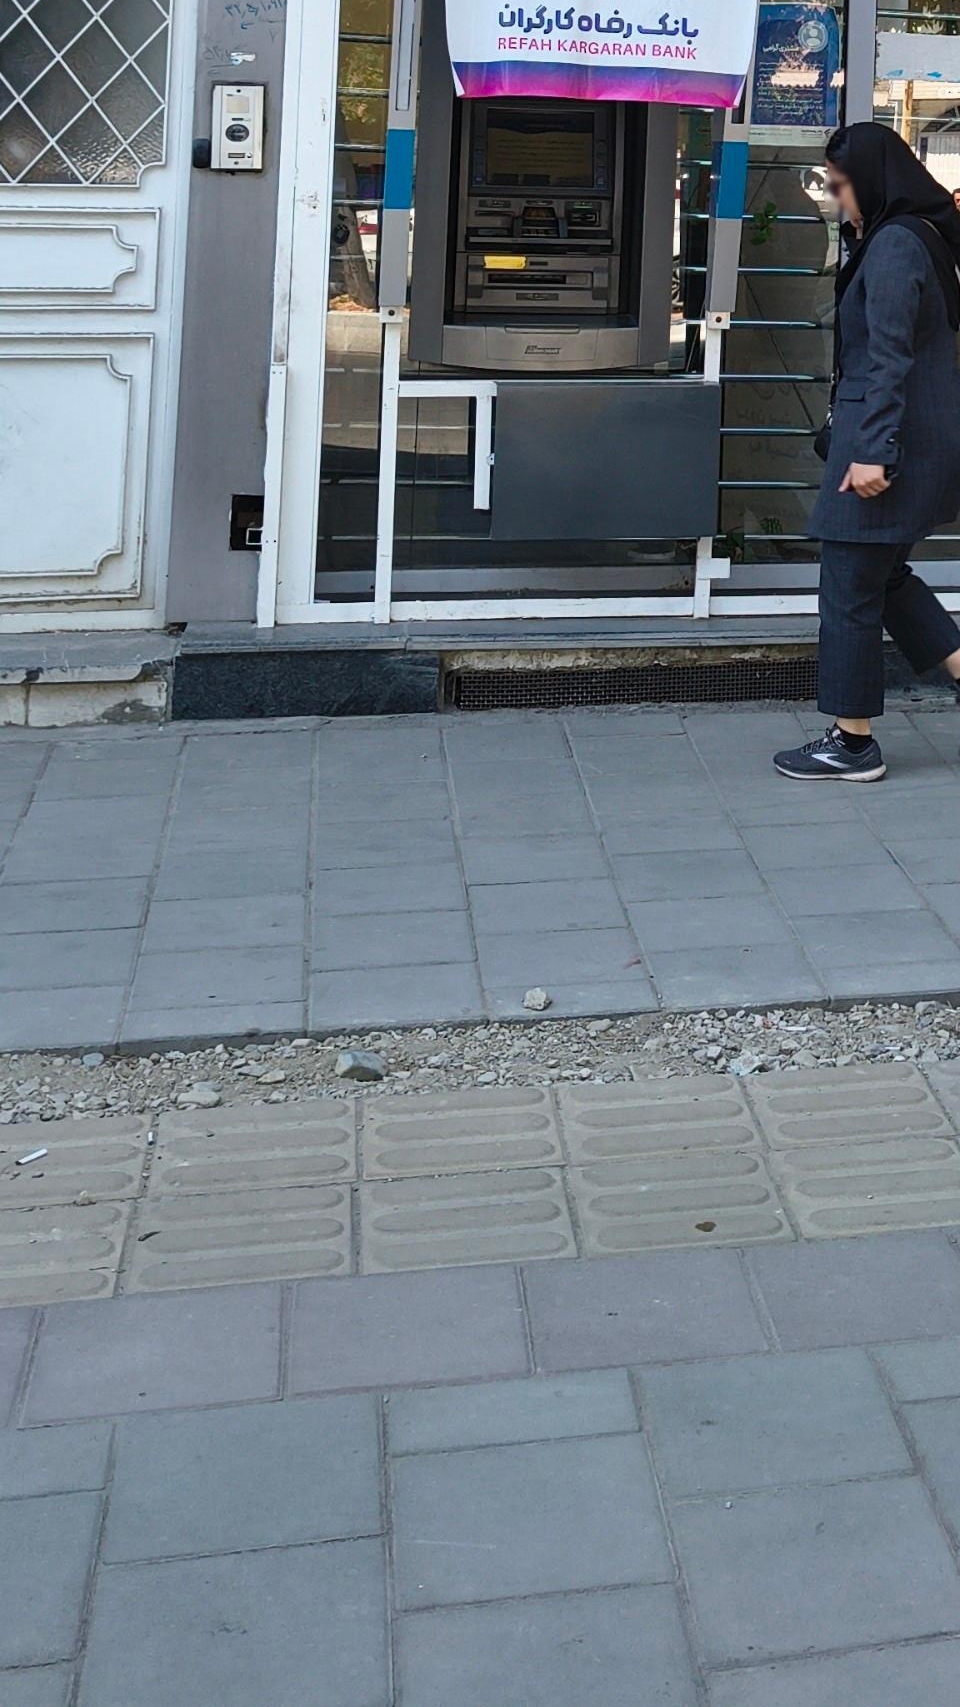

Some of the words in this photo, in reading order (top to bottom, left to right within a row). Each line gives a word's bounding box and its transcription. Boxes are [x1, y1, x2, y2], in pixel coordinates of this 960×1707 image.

[498, 3, 576, 34] کارگران
[577, 9, 633, 38] رفاه
[637, 12, 700, 45] بانک
[498, 37, 552, 51] REFAH
[557, 38, 647, 56] KARGARAN
[651, 44, 698, 60] BANK
